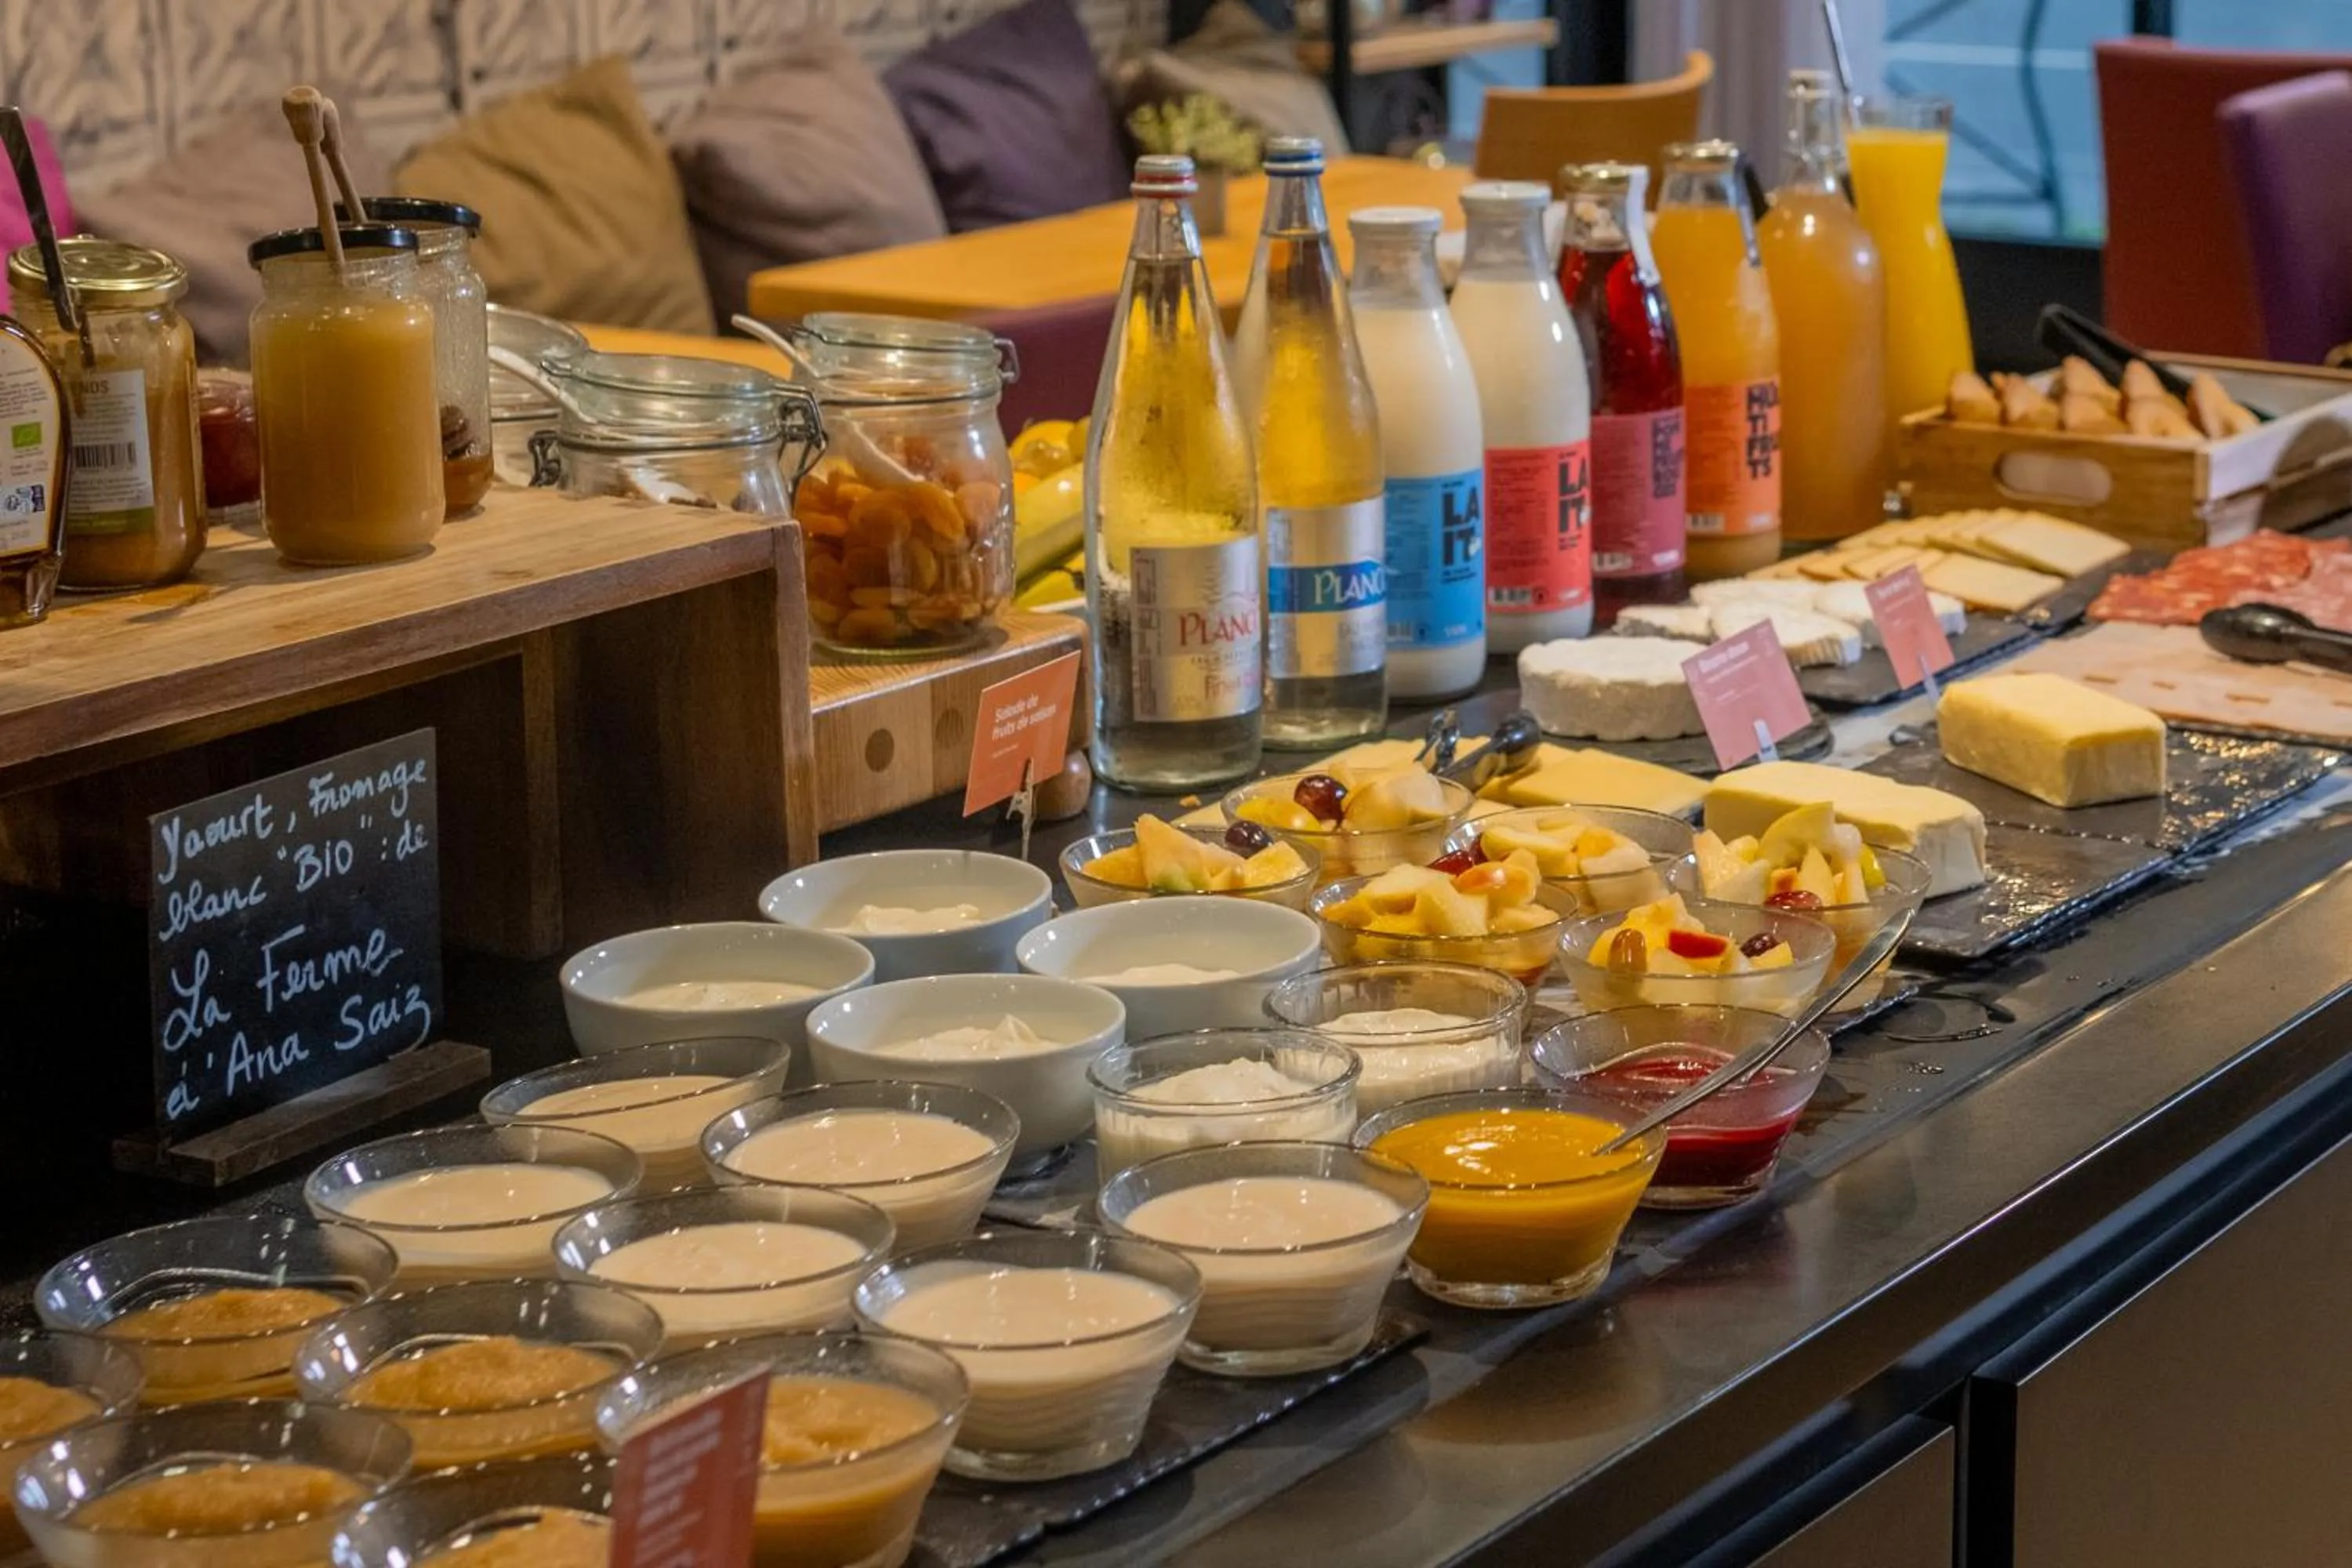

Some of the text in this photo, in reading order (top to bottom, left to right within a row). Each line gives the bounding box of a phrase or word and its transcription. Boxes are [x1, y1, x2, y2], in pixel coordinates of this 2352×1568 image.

[1442, 486, 1479, 528] LA
[308, 759, 426, 818] Fromage
[159, 874, 267, 941] blanc
[162, 924, 404, 1051] La Ferme
